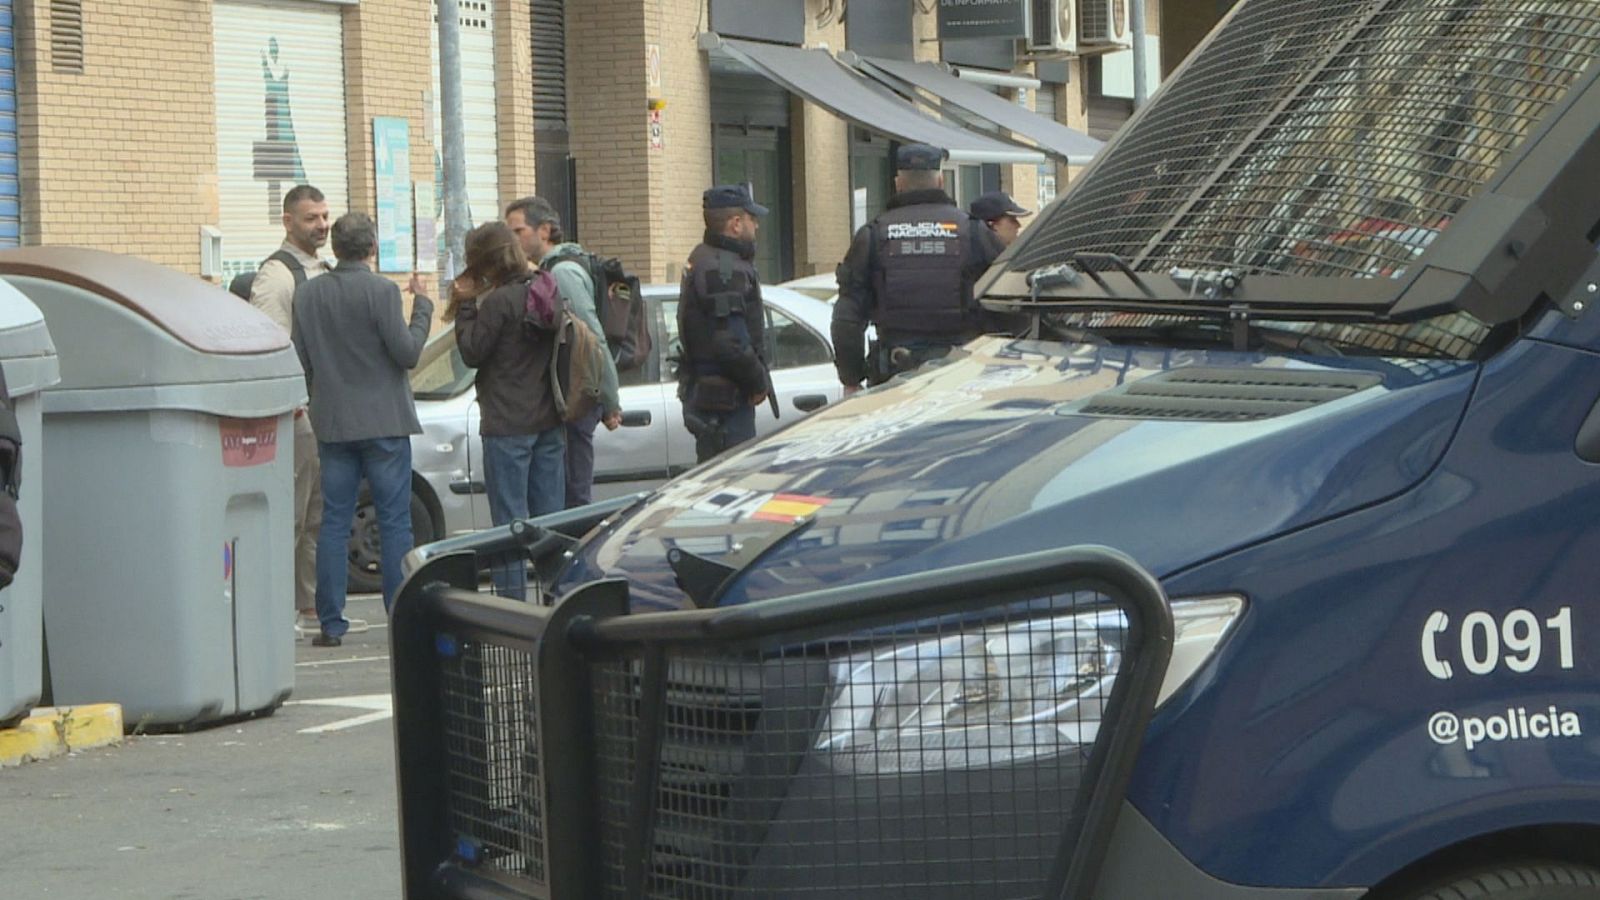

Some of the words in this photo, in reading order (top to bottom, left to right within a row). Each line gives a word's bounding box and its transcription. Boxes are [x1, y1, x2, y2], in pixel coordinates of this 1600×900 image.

[887, 222, 942, 231] POLICIA
[888, 229, 958, 239] NACIONAL
[1460, 606, 1574, 675] 091
[1428, 705, 1582, 751] @policia
